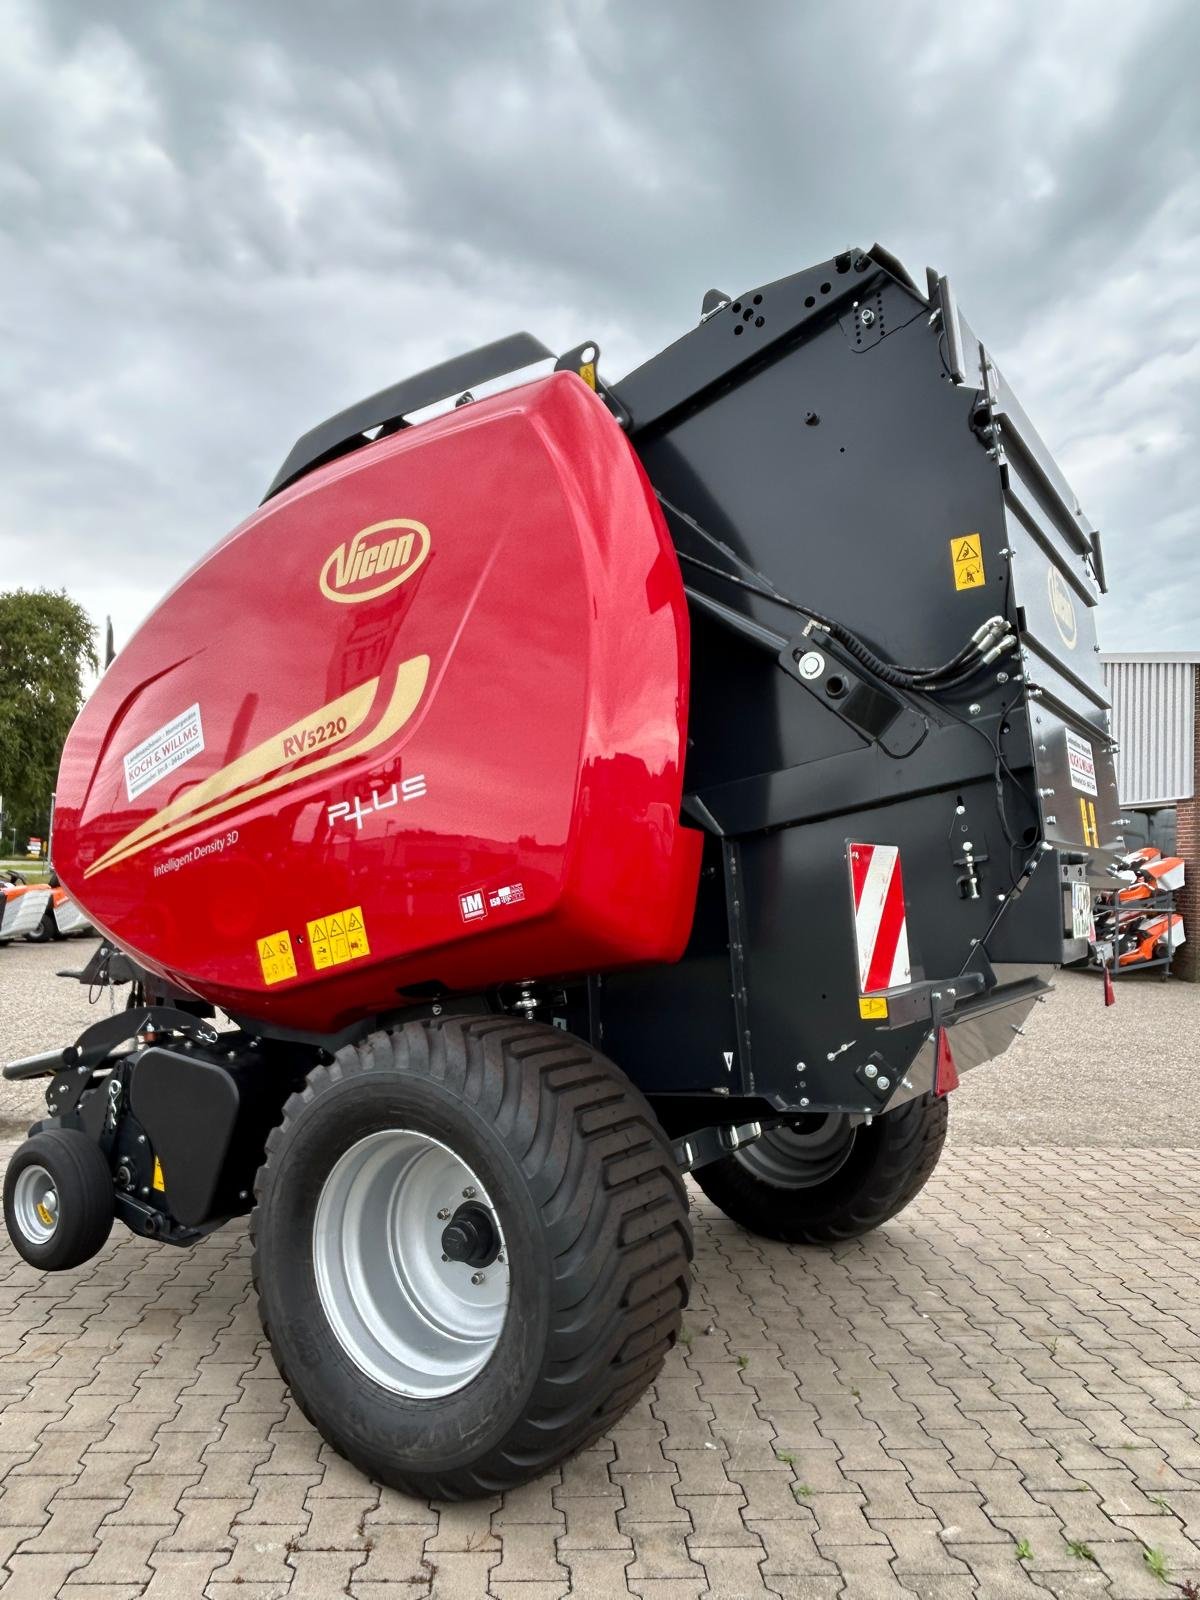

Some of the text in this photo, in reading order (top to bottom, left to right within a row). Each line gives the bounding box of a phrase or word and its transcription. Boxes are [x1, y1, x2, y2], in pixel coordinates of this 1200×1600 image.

[331, 530, 418, 590] Vicon
[128, 723, 199, 781] KOCH & WILLMS
[283, 716, 348, 758] RV5220
[153, 830, 239, 878] Intelligent Density 3D
